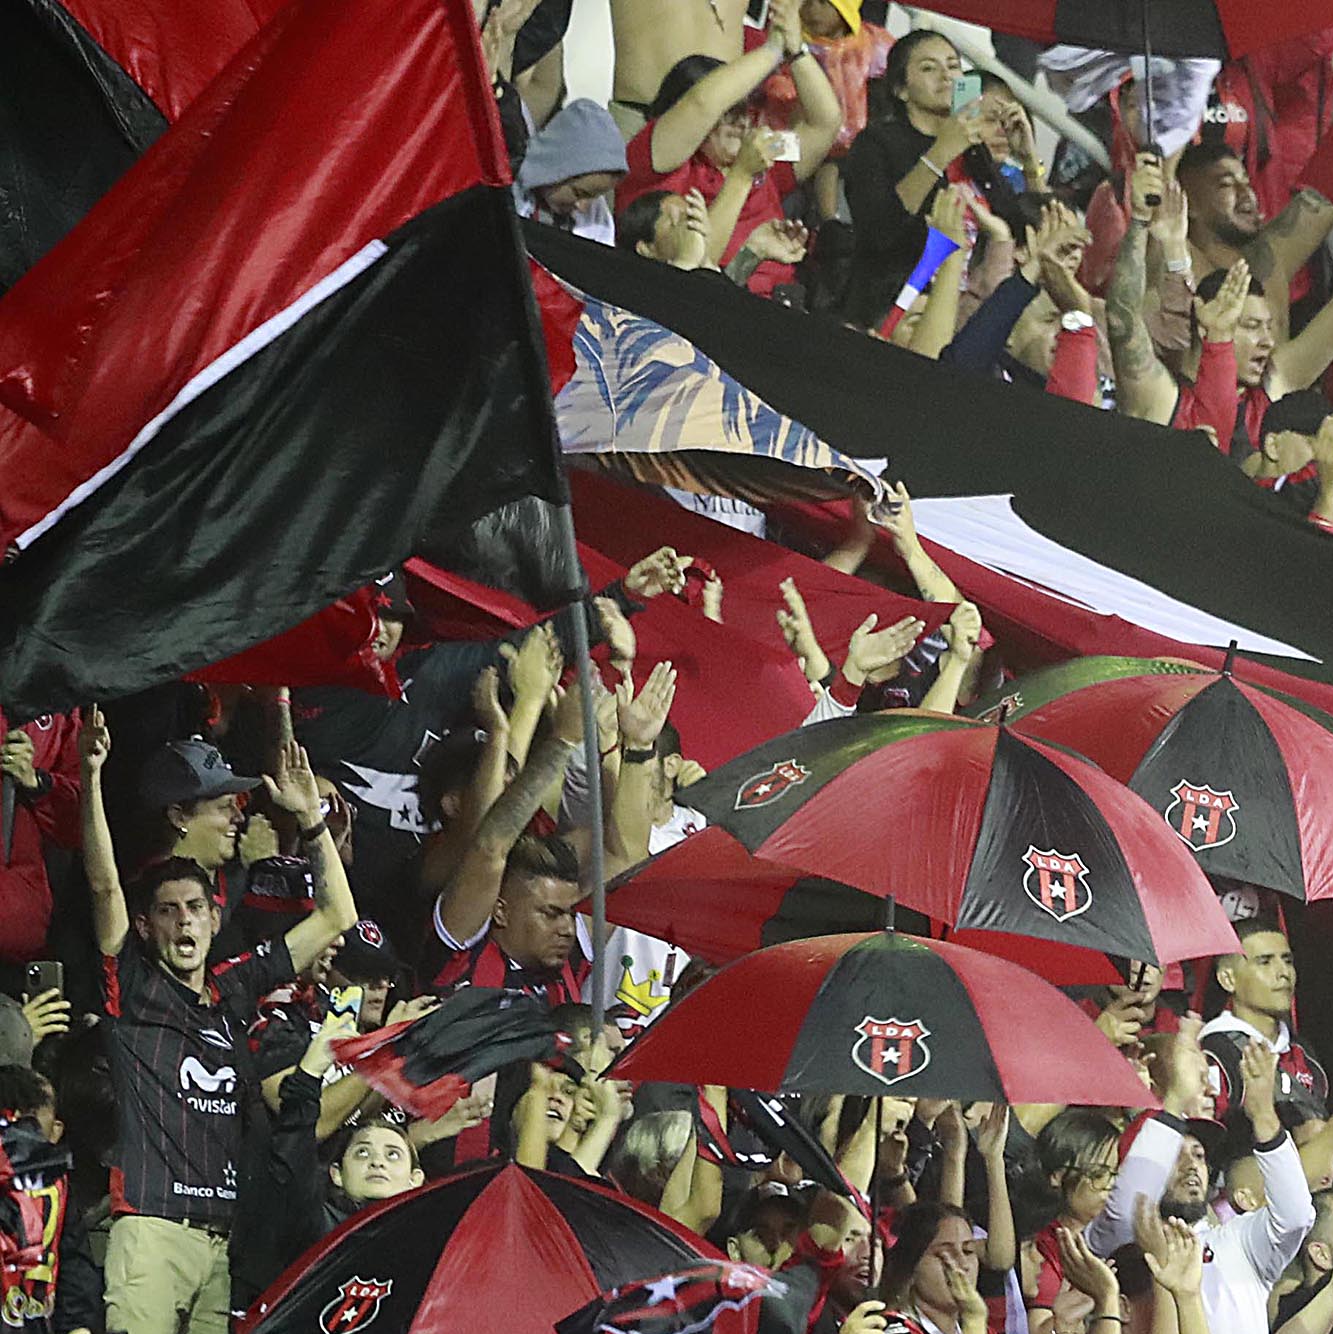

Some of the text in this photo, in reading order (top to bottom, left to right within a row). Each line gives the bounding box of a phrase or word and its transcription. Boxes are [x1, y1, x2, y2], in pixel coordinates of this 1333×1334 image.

[1184, 789, 1225, 809] LDA
[1036, 855, 1074, 874] LDA
[871, 1025, 915, 1038] LDA
[173, 1181, 215, 1198] Banco
